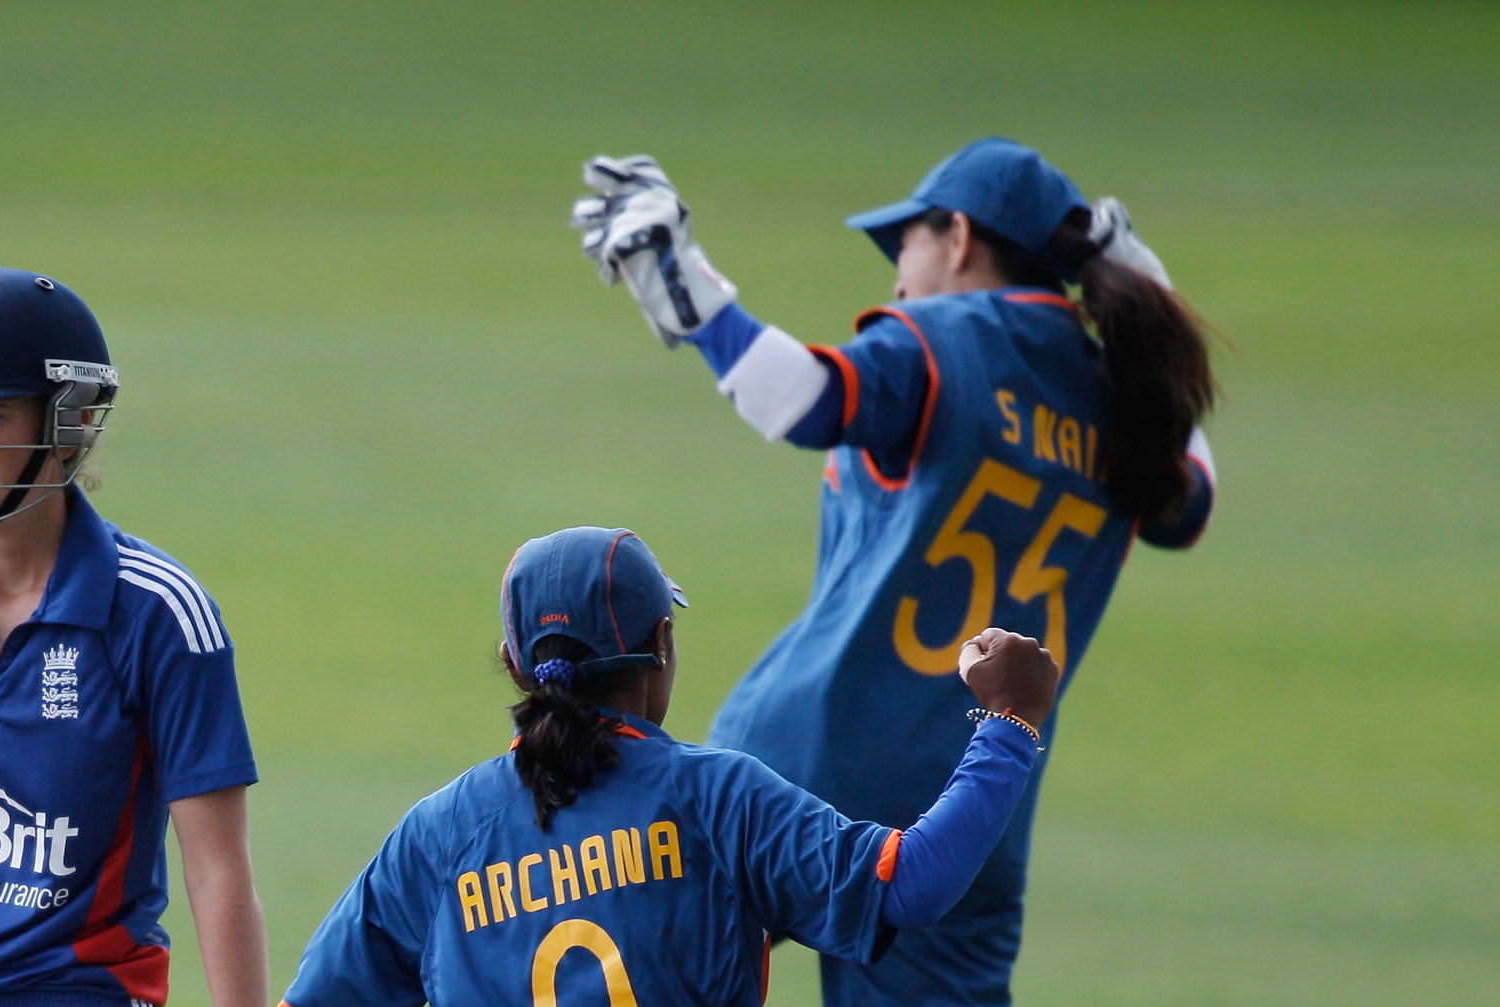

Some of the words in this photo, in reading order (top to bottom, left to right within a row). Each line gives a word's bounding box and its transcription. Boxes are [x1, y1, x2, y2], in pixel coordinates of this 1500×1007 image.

[996, 388, 1021, 445] S
[1033, 403, 1100, 482] NAI
[892, 457, 1108, 677] 55
[540, 613, 569, 626] INDIA
[457, 820, 684, 933] ARCHANA
